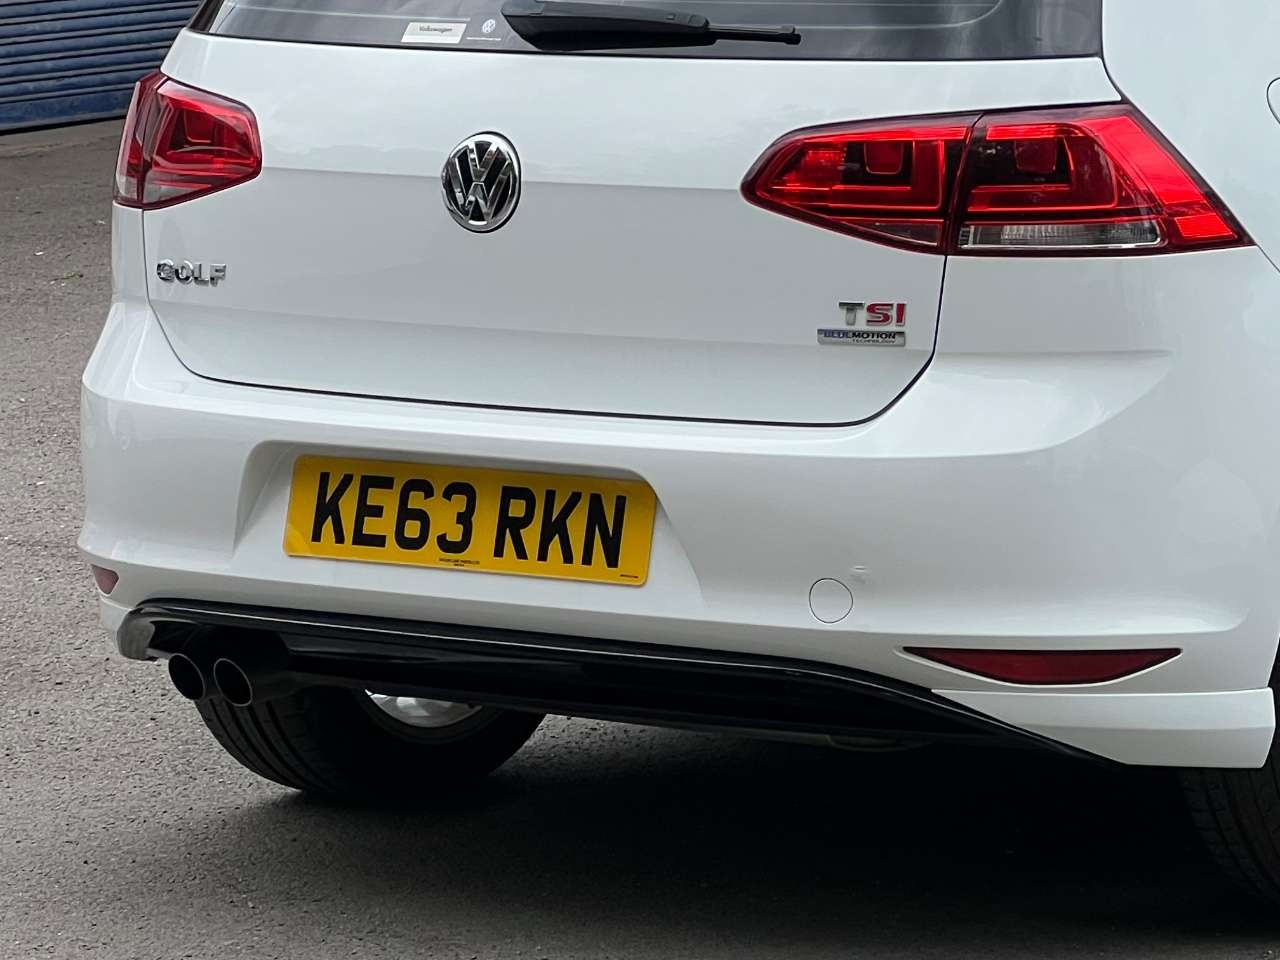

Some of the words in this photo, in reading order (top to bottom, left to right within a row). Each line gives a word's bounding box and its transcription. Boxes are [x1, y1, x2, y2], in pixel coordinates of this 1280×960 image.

[156, 259, 227, 287] GOLF
[838, 301, 906, 327] TSI
[311, 471, 477, 554] KE63
[493, 485, 627, 568] RKN
